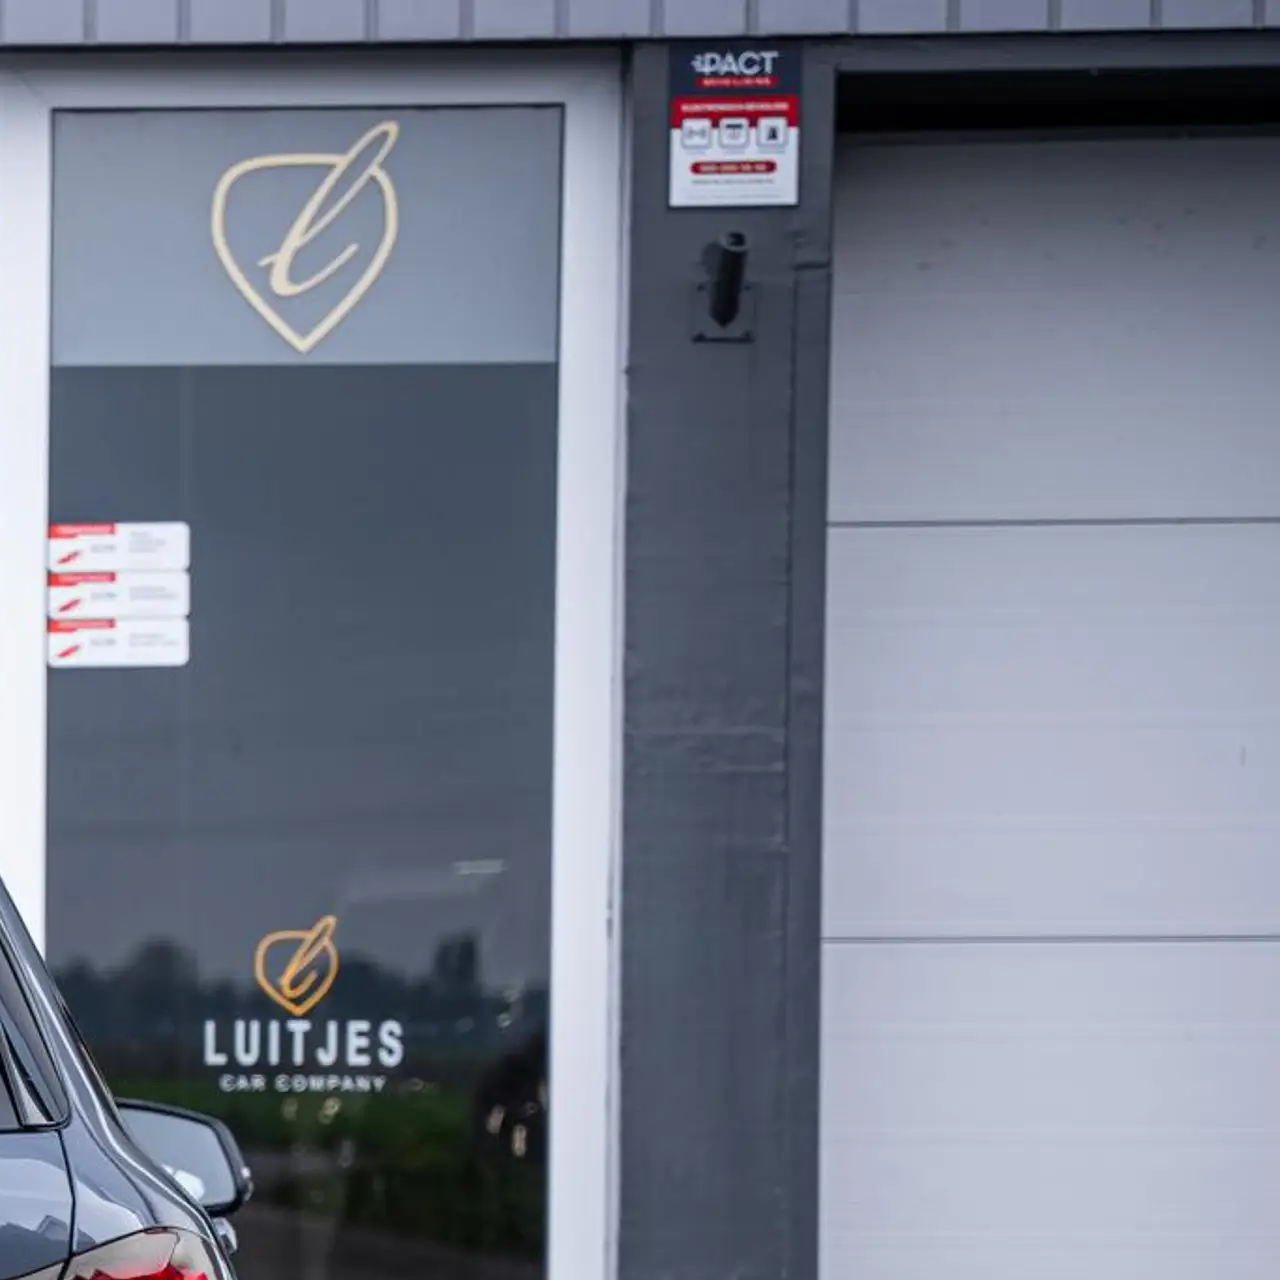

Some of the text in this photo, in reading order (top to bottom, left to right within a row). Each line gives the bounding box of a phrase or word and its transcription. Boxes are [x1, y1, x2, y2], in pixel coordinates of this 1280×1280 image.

[203, 1018, 406, 1068] LUITJES
[218, 1074, 387, 1094] CAR COMPANY
